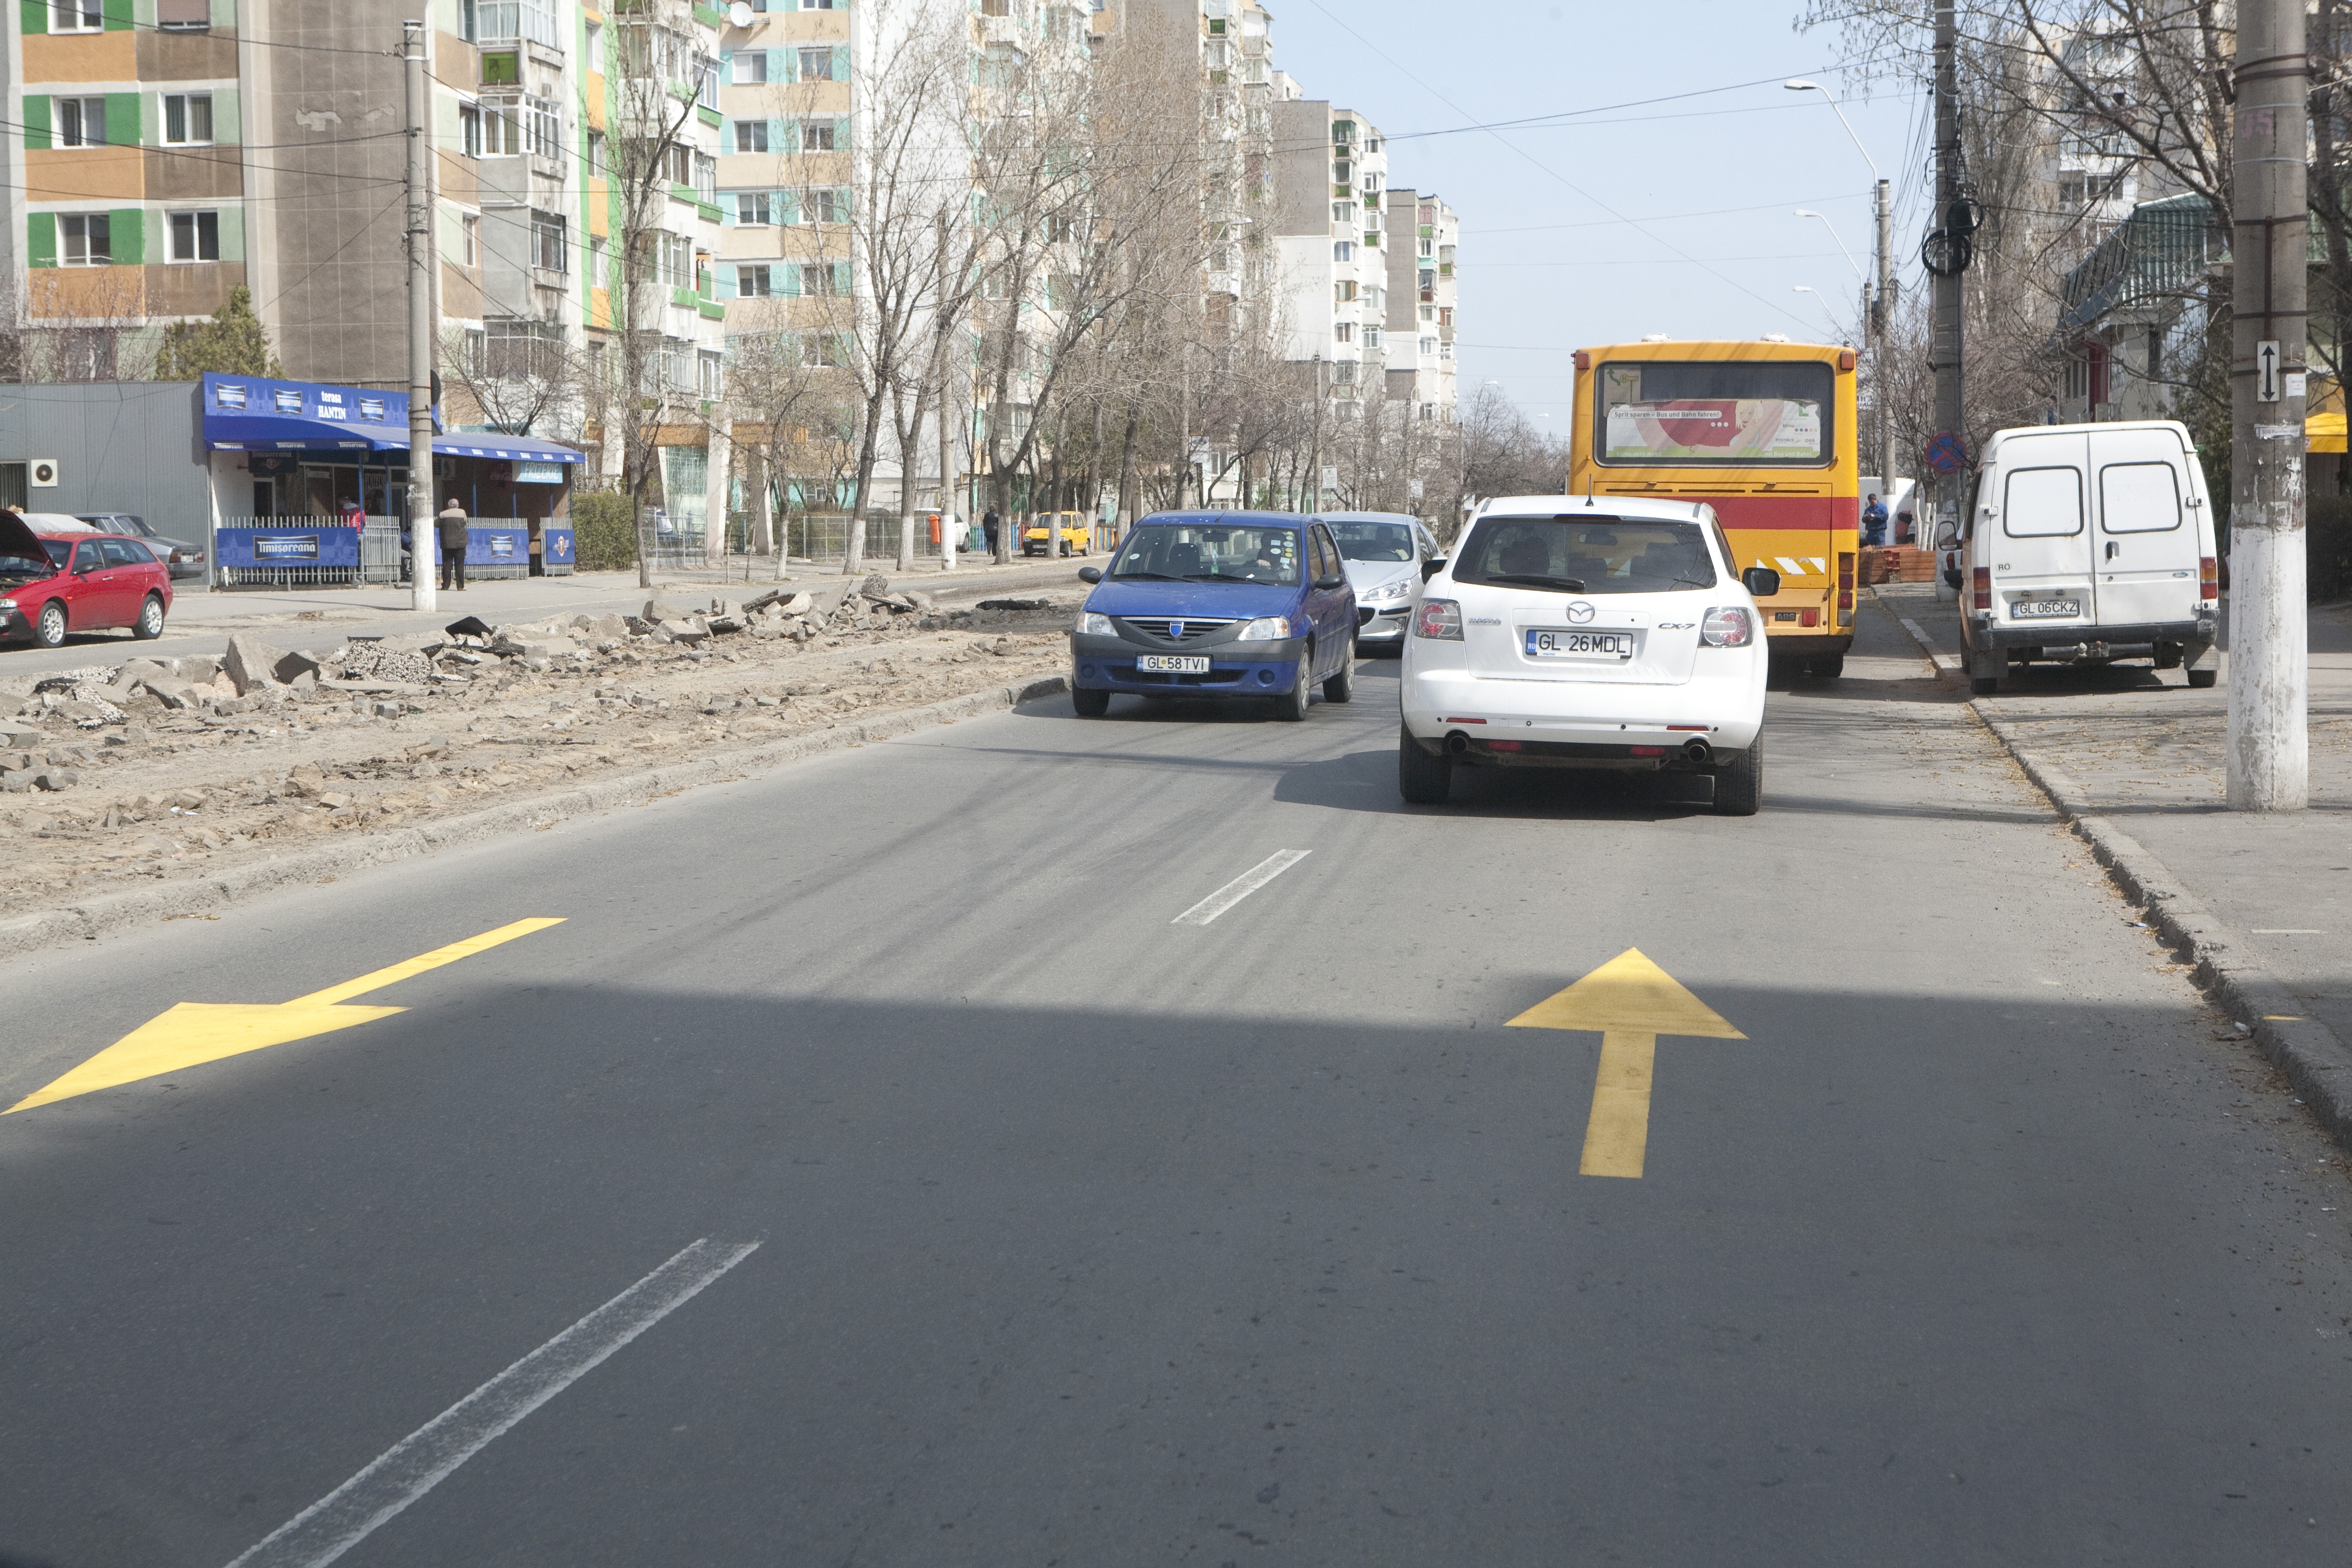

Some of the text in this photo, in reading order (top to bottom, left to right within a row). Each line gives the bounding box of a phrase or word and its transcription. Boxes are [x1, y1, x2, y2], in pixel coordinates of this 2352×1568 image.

[321, 391, 342, 403] terasa
[318, 405, 346, 419] HANTIN
[524, 462, 559, 480] FRIZERIE
[2020, 603, 2034, 614] GL
[1539, 634, 1561, 650] GL
[1147, 656, 1163, 669] GL
